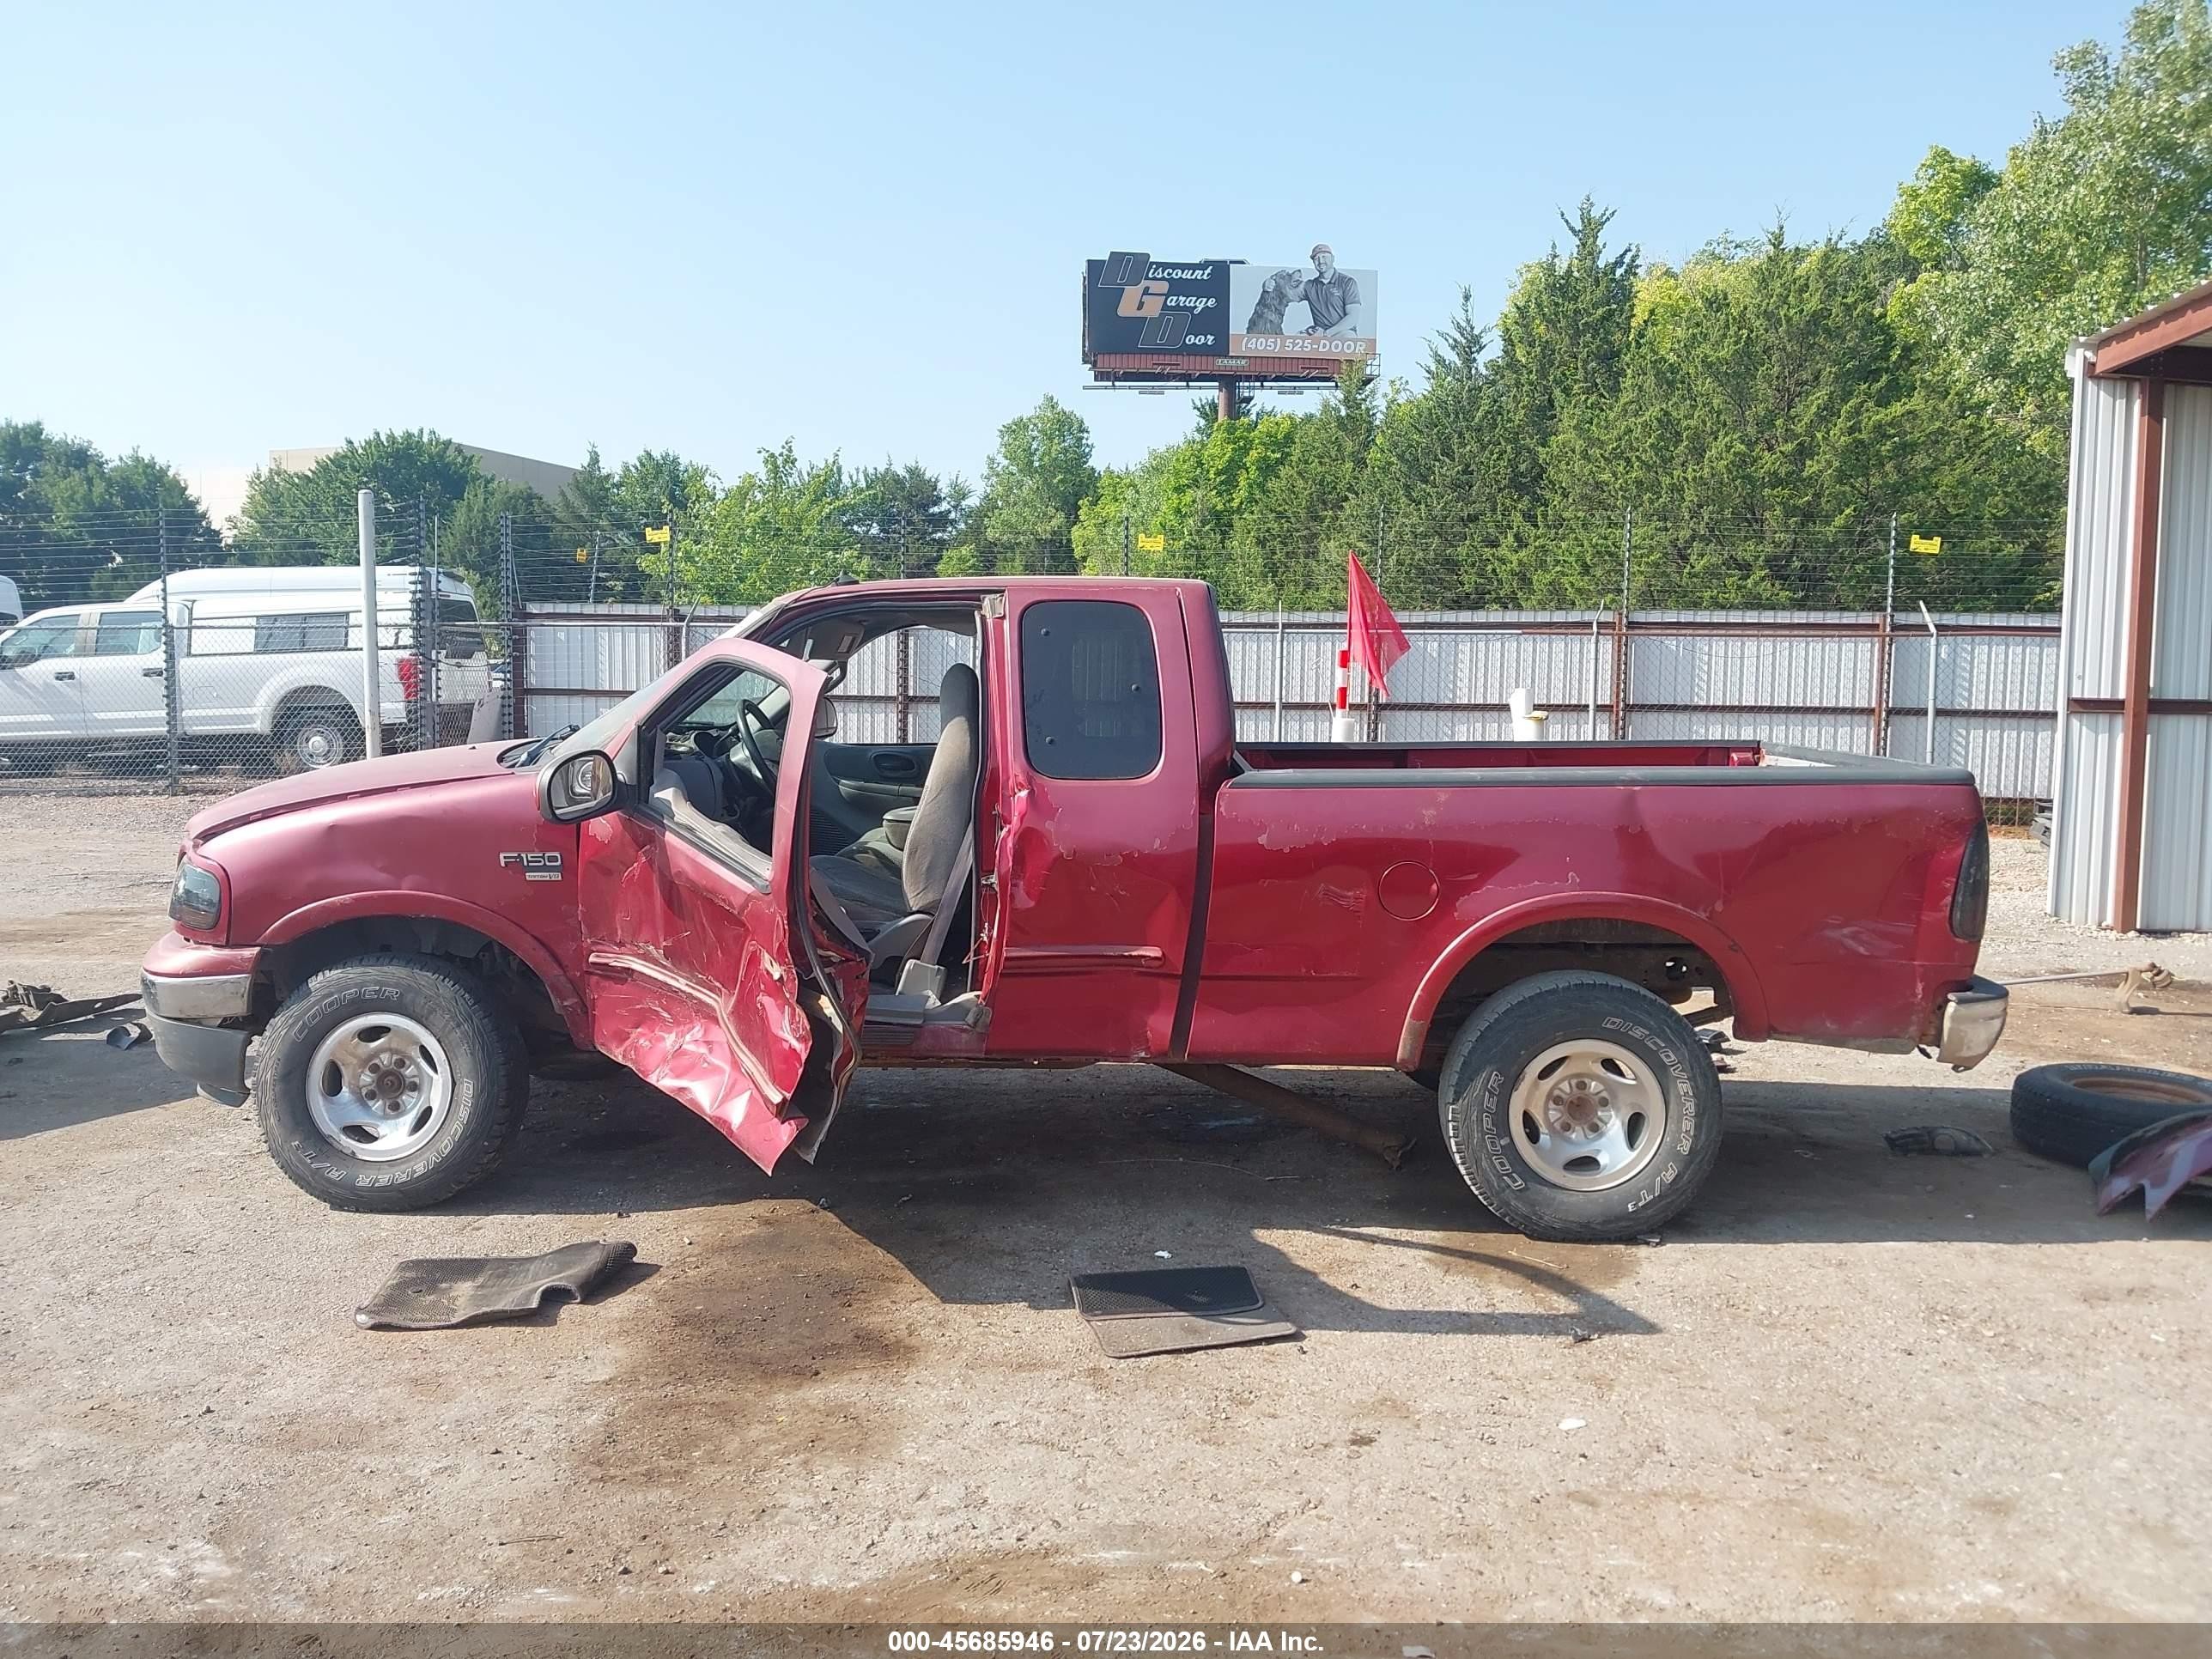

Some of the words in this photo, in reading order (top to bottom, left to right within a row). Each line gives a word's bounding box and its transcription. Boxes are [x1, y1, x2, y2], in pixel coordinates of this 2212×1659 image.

[1098, 251, 1213, 288] Discount
[1117, 280, 1217, 317] Garage
[1138, 311, 1215, 349] Door
[1242, 337, 1281, 353] (405)
[1285, 338, 1366, 354] 525-DOOR
[292, 986, 400, 1042] COOPER
[1601, 1016, 1696, 1155] DISCOVERER
[355, 1078, 474, 1188] DISCOVERER
[1482, 1070, 1525, 1191] COOPER
